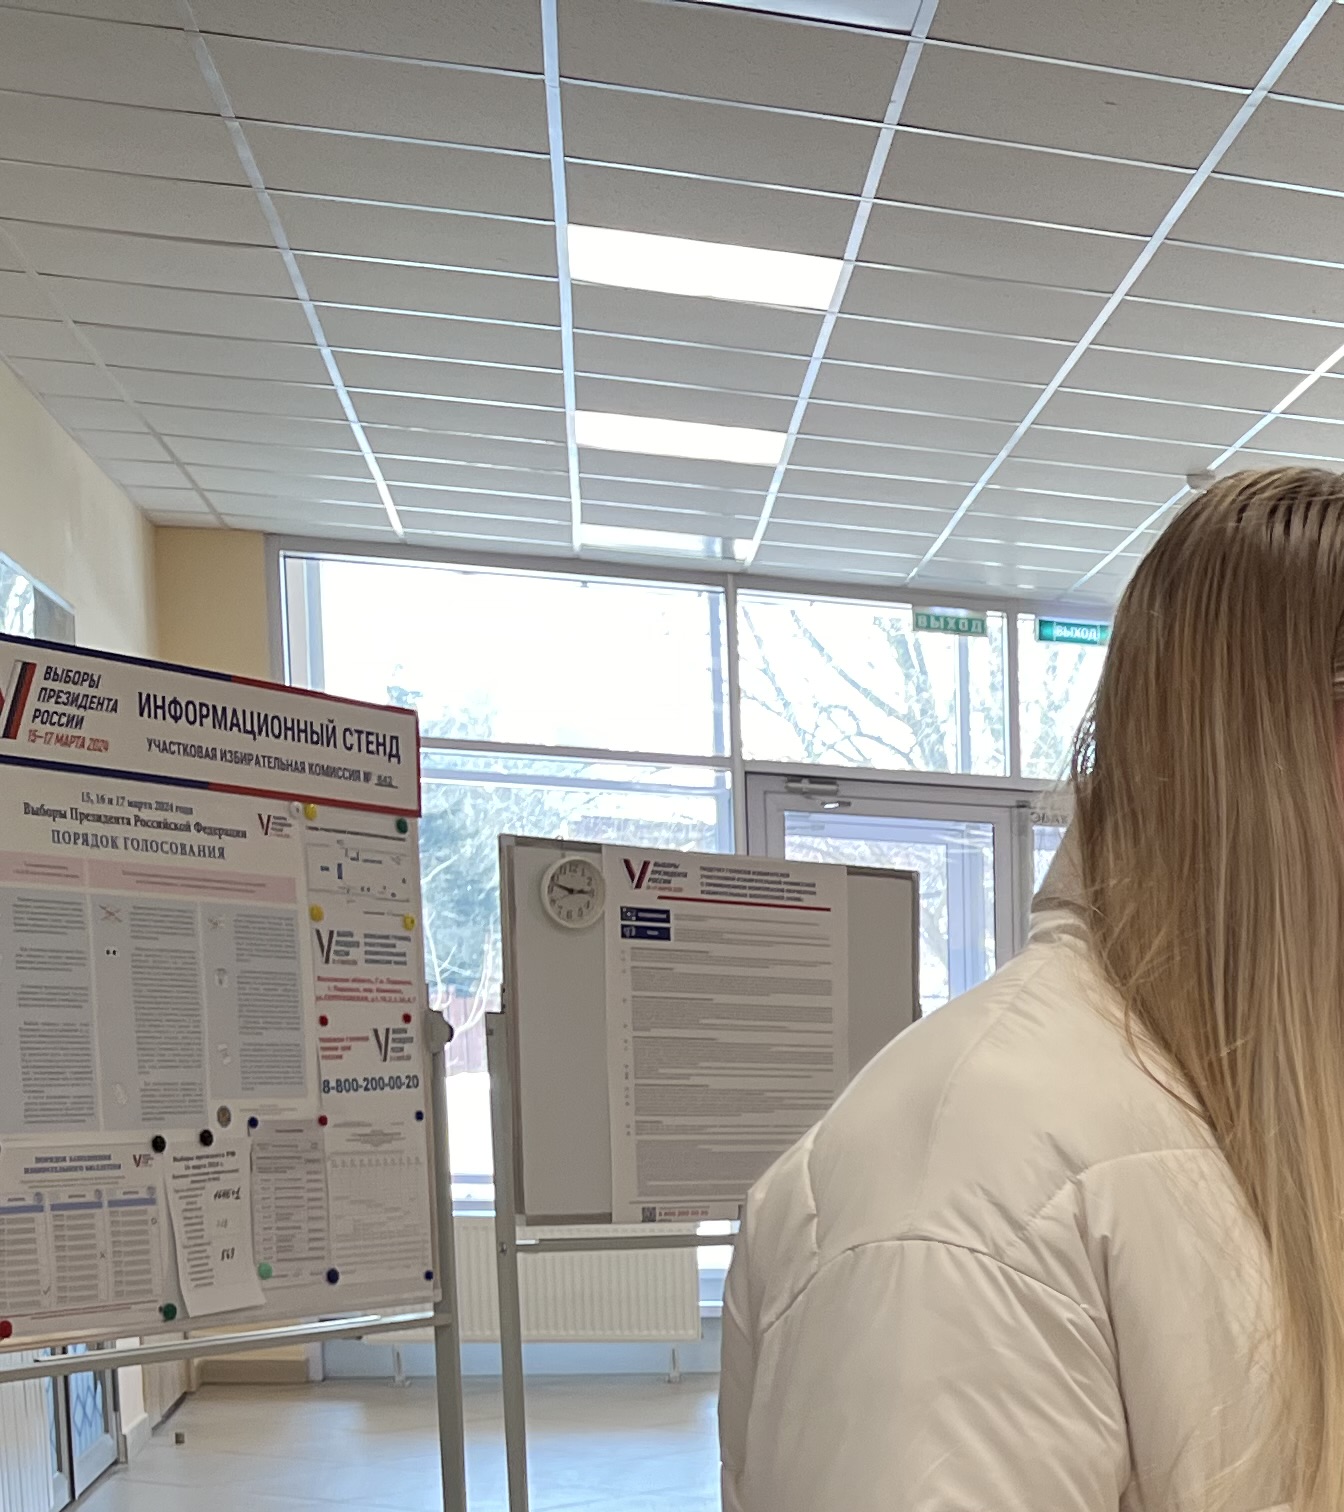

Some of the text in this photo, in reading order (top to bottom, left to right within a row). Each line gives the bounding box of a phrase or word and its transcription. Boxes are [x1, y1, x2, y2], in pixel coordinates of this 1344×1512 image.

[916, 614, 983, 634] ВЫХОД
[1055, 623, 1099, 642] ВЫХОД
[43, 665, 102, 689] ВЫБОРЫ
[37, 686, 119, 713] ПРЕЗИДЕНТА
[31, 708, 86, 731] РОССИИ
[138, 691, 402, 765] ИНФОРМАЦИОННЫЙ СТЕНД
[55, 733, 86, 750] МАРТА
[146, 737, 218, 762] УЧАСТКОВАЯ
[219, 747, 306, 775] ИЗБИРАТЕЛЬНАЯ
[307, 762, 362, 783] КОМИССИЯ
[23, 802, 67, 822] Выборы
[69, 806, 132, 826] Президента
[133, 814, 192, 833] Российской
[51, 829, 226, 859] ПОРЯДОК ГОЛОСОВАНИЯ
[321, 1074, 420, 1095] 8-800-200-00-20
